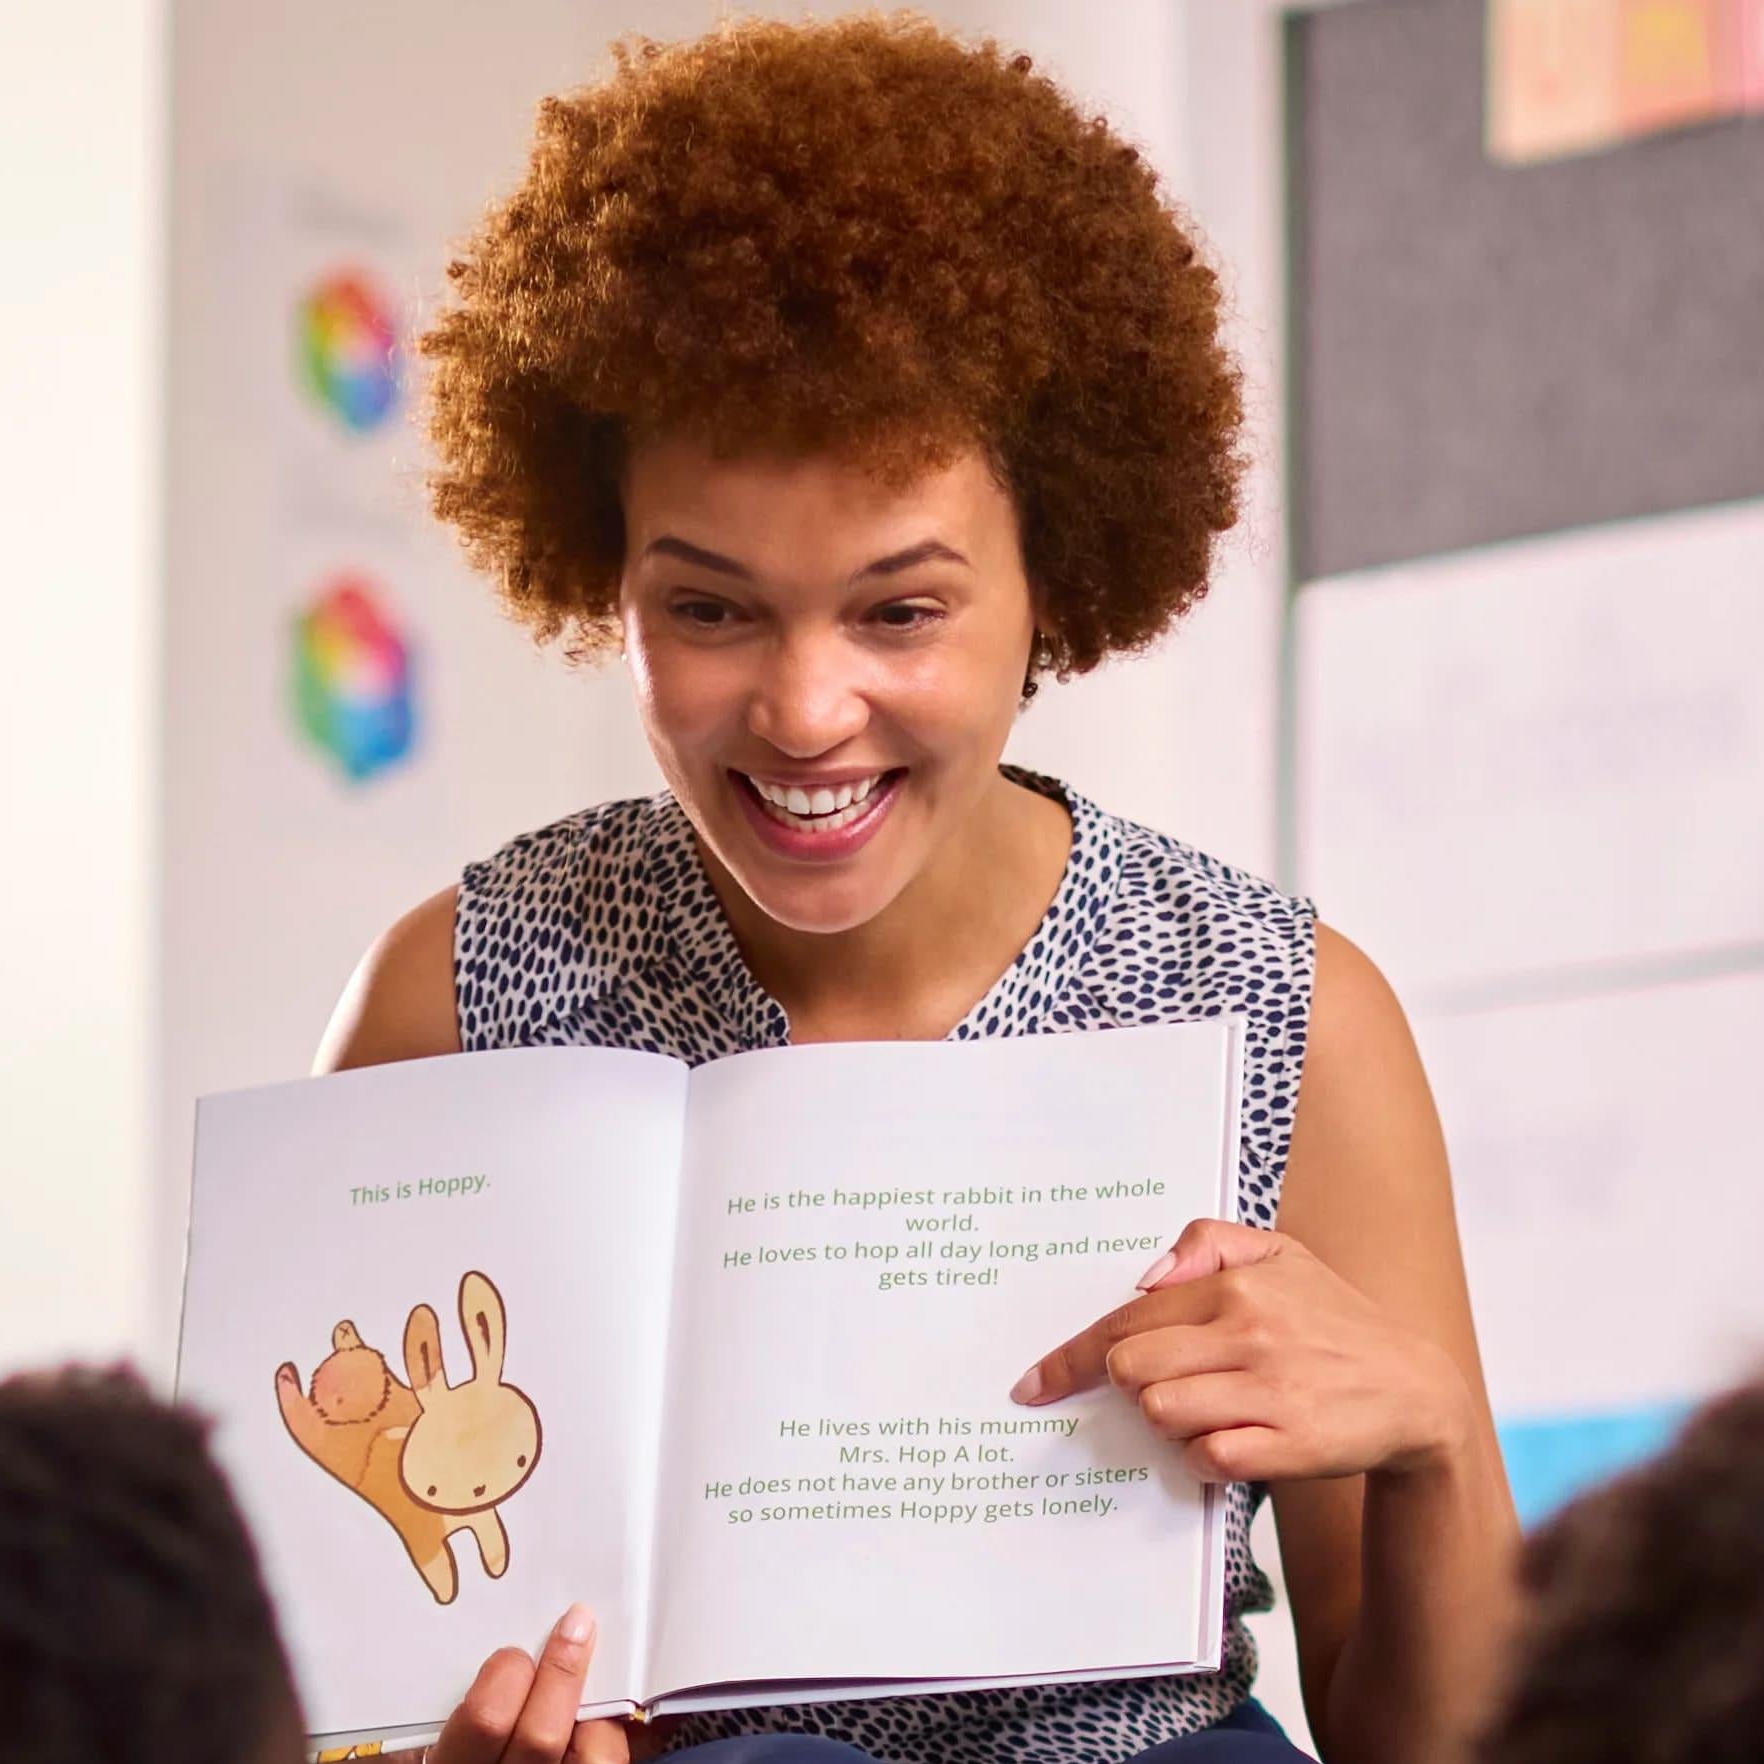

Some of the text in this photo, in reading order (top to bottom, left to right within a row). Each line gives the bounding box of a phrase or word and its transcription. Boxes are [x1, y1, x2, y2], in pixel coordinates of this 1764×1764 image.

[350, 1175, 490, 1205] This is Hoppy.
[728, 1178, 1165, 1214] He is the happiest rabbit in the whole
[906, 1214, 979, 1231] world.
[724, 1236, 1163, 1268] He loves to hop all day long and never
[878, 1268, 998, 1290] gets tired!
[780, 1417, 1078, 1437] He lives with his mummy
[840, 1444, 1013, 1468] Mrs. Hop A lot.
[705, 1467, 1147, 1499] He does not have any brother or sisters
[728, 1494, 1117, 1524] so sometimes Hoppy gets lonely.
